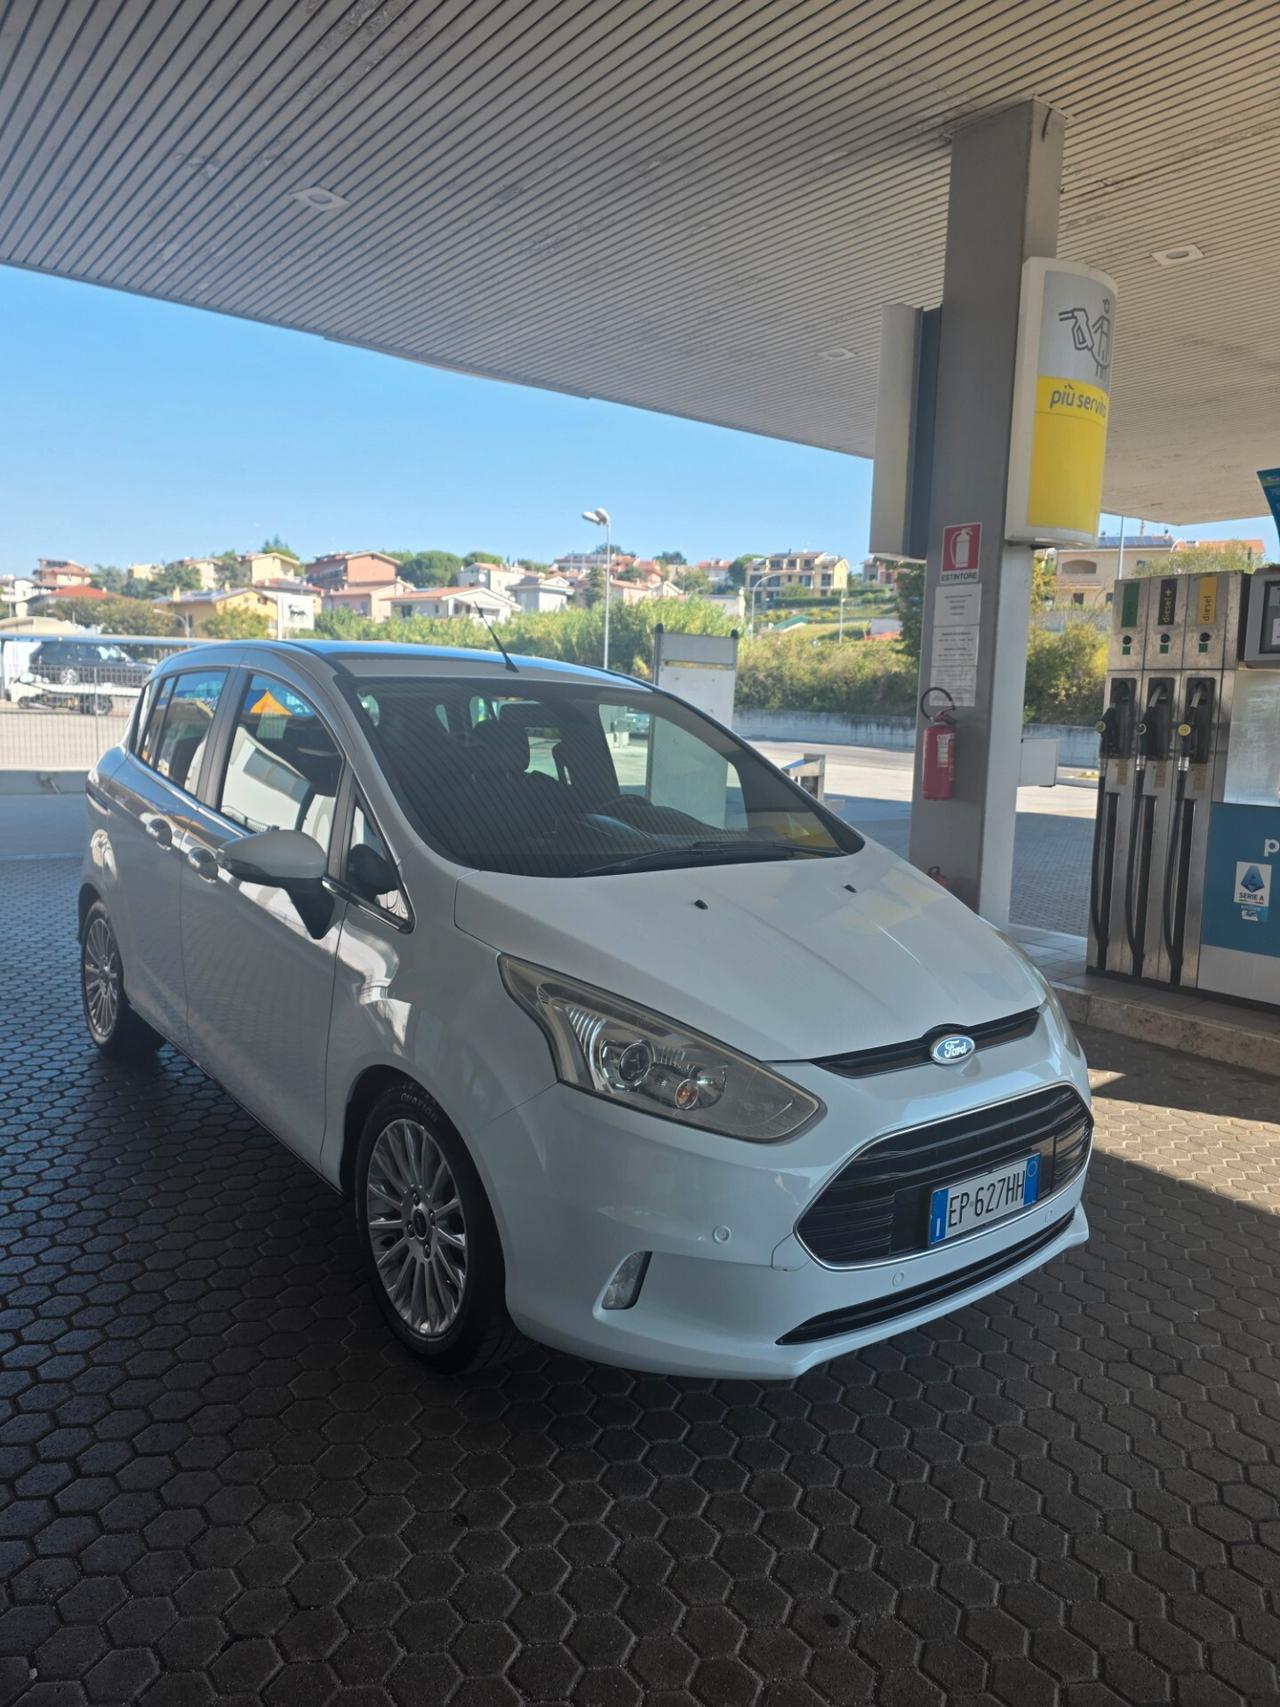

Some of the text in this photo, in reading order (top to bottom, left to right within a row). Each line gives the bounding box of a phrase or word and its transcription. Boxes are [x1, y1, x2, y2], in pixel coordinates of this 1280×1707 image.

[1050, 383, 1107, 418] più servi
[941, 571, 977, 581] ESTINTORE
[1202, 595, 1213, 622] diesel
[1239, 892, 1258, 901] SERIE
[944, 1040, 967, 1058] Ford
[947, 1191, 970, 1228] EP
[974, 1169, 1026, 1217] 627HH
